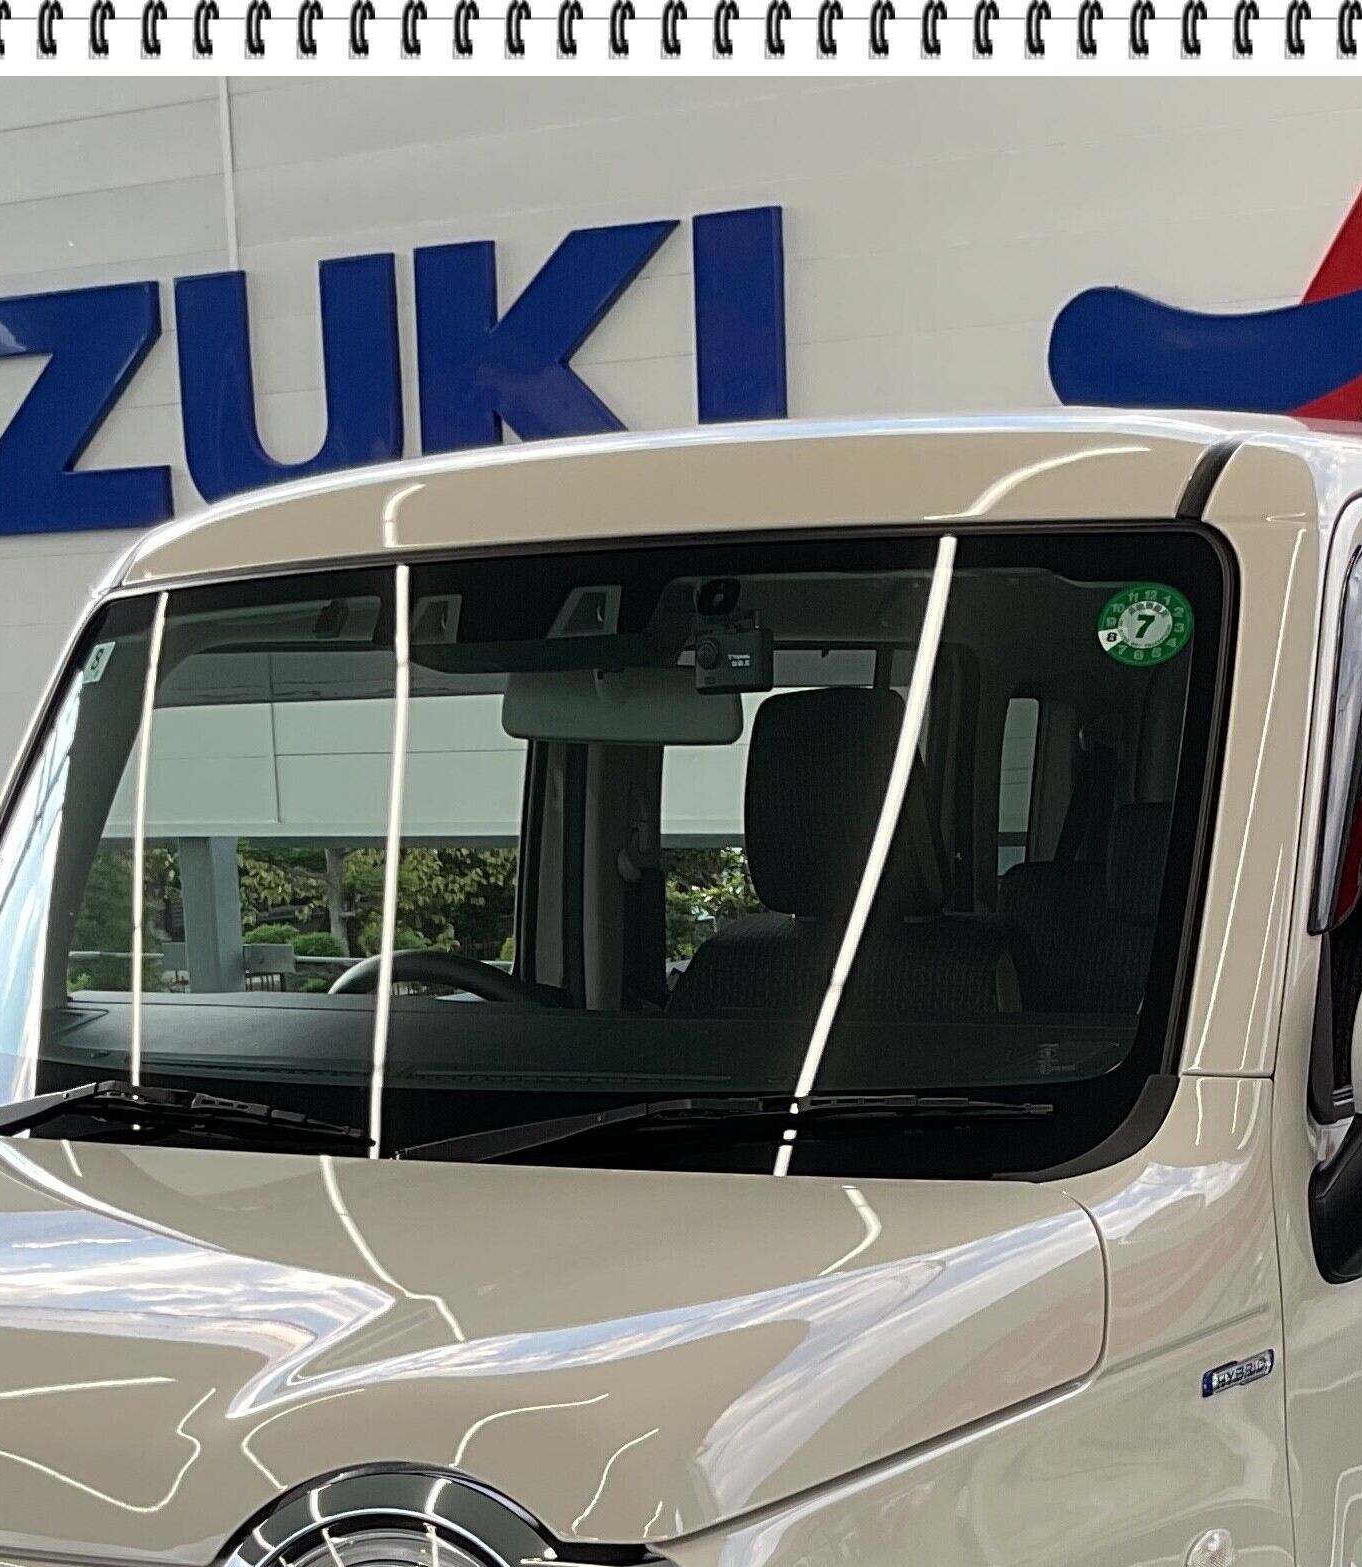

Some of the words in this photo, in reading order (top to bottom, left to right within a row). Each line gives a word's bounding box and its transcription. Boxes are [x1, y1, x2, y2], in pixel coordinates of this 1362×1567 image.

[1106, 632, 1117, 642] 8
[1135, 614, 1156, 639] 7
[1214, 1357, 1267, 1389] HYBRID
